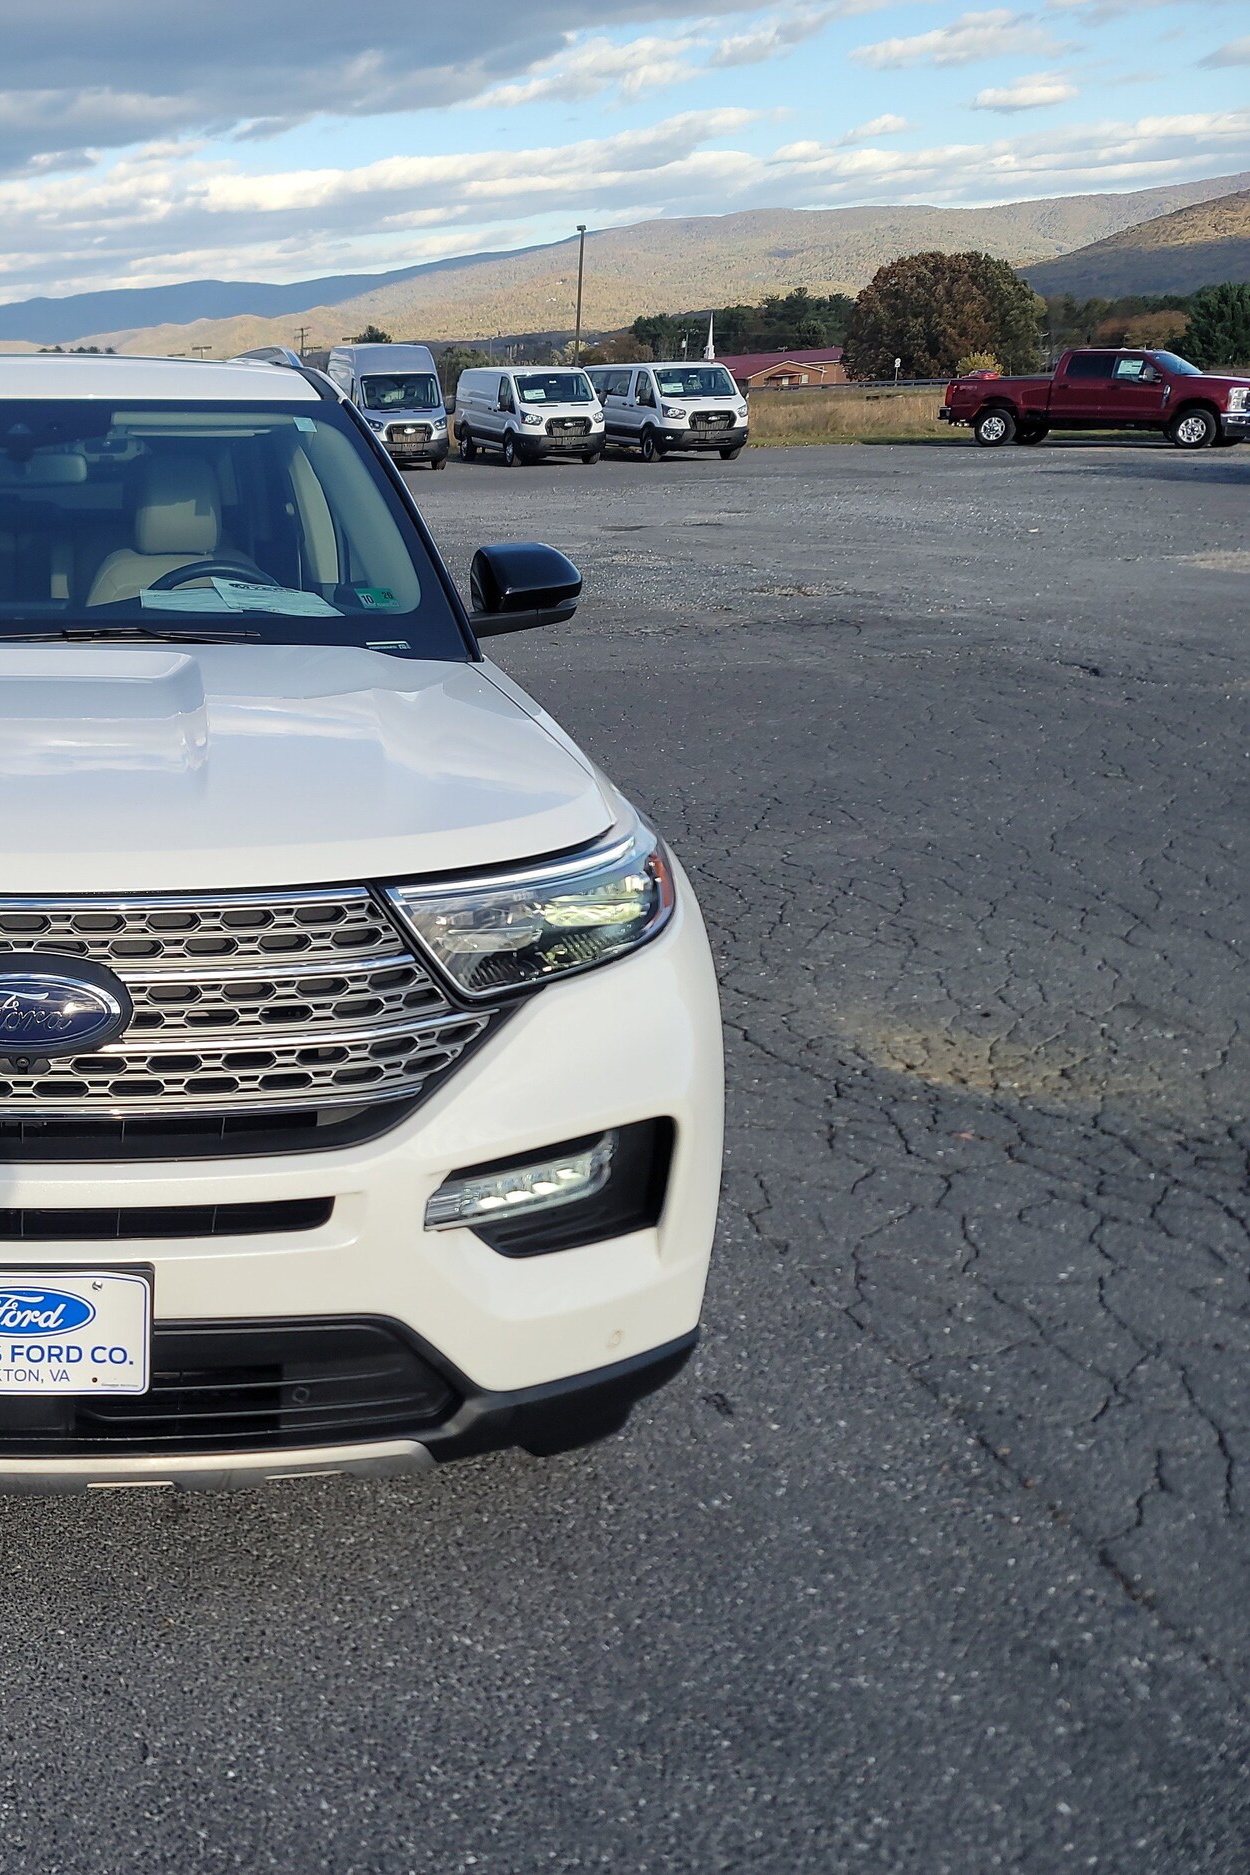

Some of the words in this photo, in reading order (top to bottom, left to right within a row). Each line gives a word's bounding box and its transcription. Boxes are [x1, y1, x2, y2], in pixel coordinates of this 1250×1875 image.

[360, 594, 375, 605] 10
[10, 1345, 83, 1363] FORD
[90, 1345, 134, 1365] CO.
[49, 1369, 70, 1382] VA
